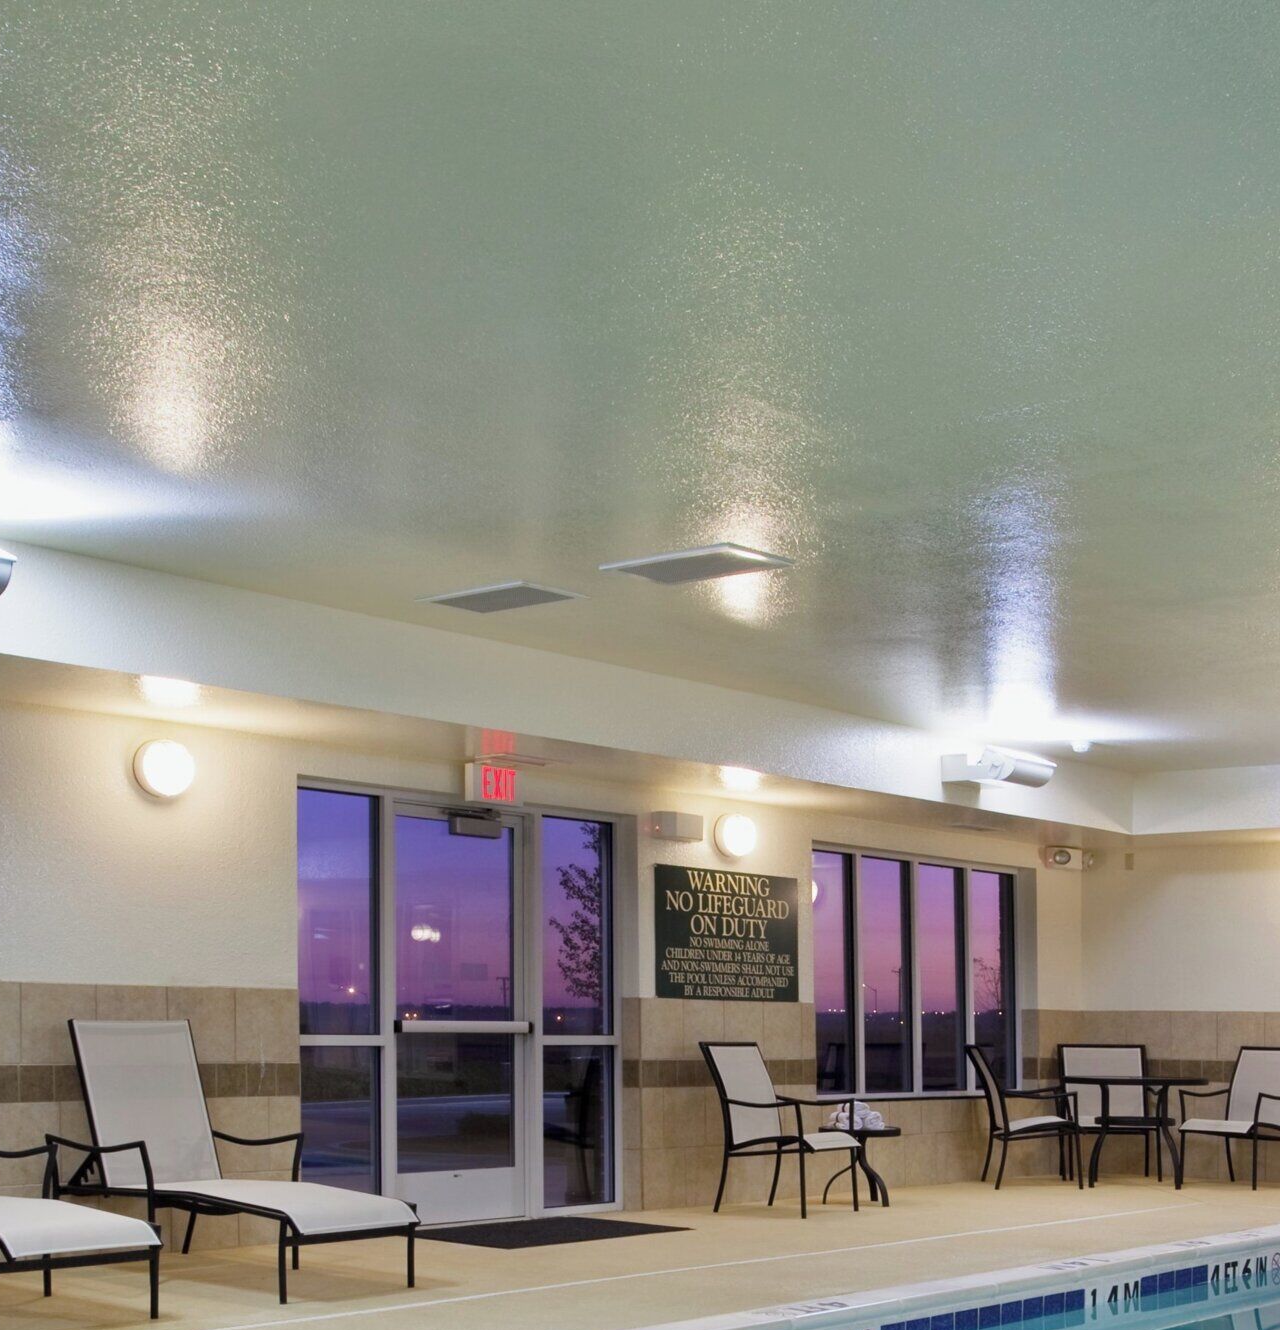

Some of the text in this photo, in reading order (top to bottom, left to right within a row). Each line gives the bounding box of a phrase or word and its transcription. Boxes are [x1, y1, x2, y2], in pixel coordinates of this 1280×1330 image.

[482, 765, 516, 801] EXIT
[687, 870, 770, 897] WARNING
[666, 890, 789, 920] NO LIFEGUARD
[691, 914, 768, 939] ON DUTY
[690, 936, 769, 952] NO SWIMMING ALONE
[665, 948, 705, 960] CHILDREN
[706, 950, 733, 961] UNDER
[743, 953, 765, 964] YEARS
[765, 954, 776, 964] OF
[777, 955, 791, 965] AGE
[661, 960, 794, 977] AND NON-SWIMMERS SHALL NOT USE
[669, 972, 788, 988] THE POOL UNLESS ACCOMPANIED
[684, 985, 775, 999] BY A RESPONSIBLE ADULT
